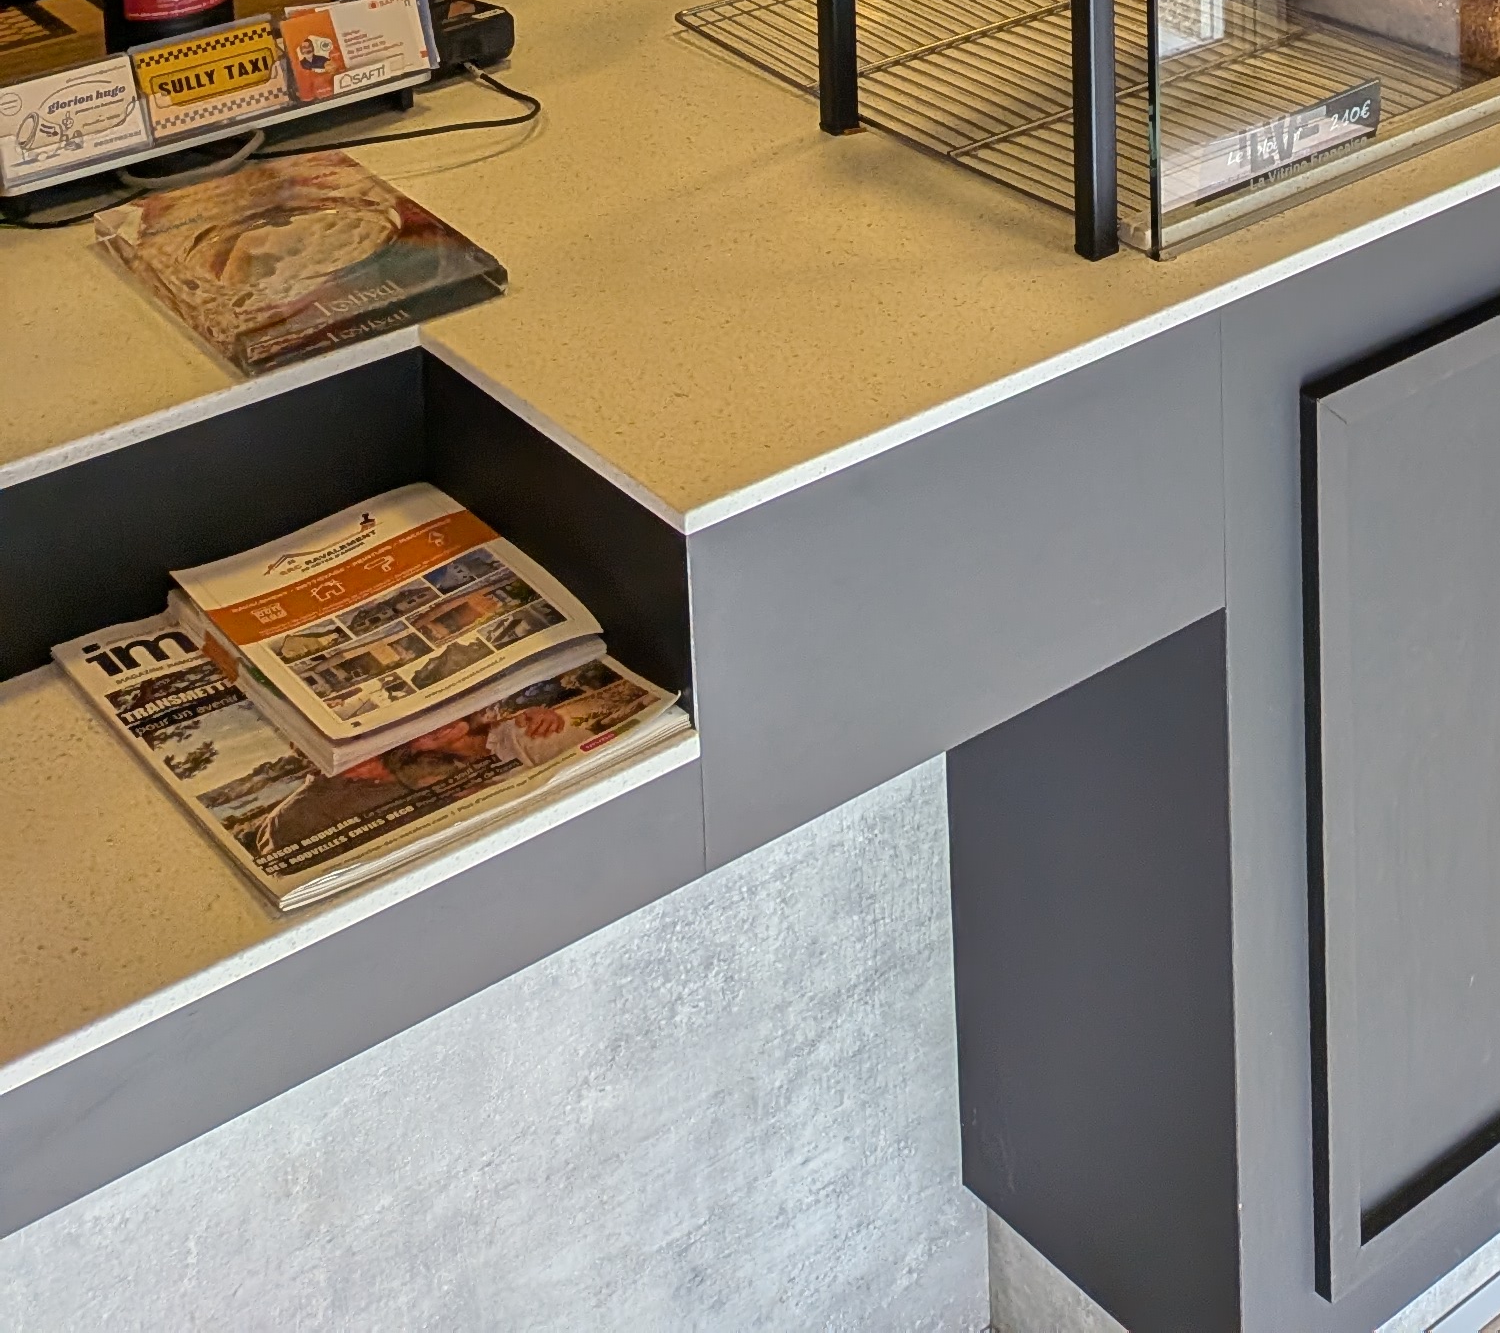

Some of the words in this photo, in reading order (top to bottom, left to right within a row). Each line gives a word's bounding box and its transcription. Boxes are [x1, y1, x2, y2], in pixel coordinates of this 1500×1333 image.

[95, 85, 126, 100] hugo
[157, 71, 218, 97] SULLY
[223, 55, 270, 83] TAXI
[352, 64, 386, 85] SAFTI
[1226, 150, 1244, 166] Le
[1250, 176, 1266, 191] La
[304, 529, 377, 566] RAVALEMENT
[81, 630, 200, 677] im
[134, 717, 170, 735] pour
[172, 710, 194, 722] un
[196, 693, 238, 714] avenir
[256, 843, 300, 866] MAISON
[300, 816, 362, 848] MODULAIRE
[264, 860, 288, 874] DES
[288, 836, 349, 865] NOUVELLES
[348, 818, 386, 839] ENVIES
